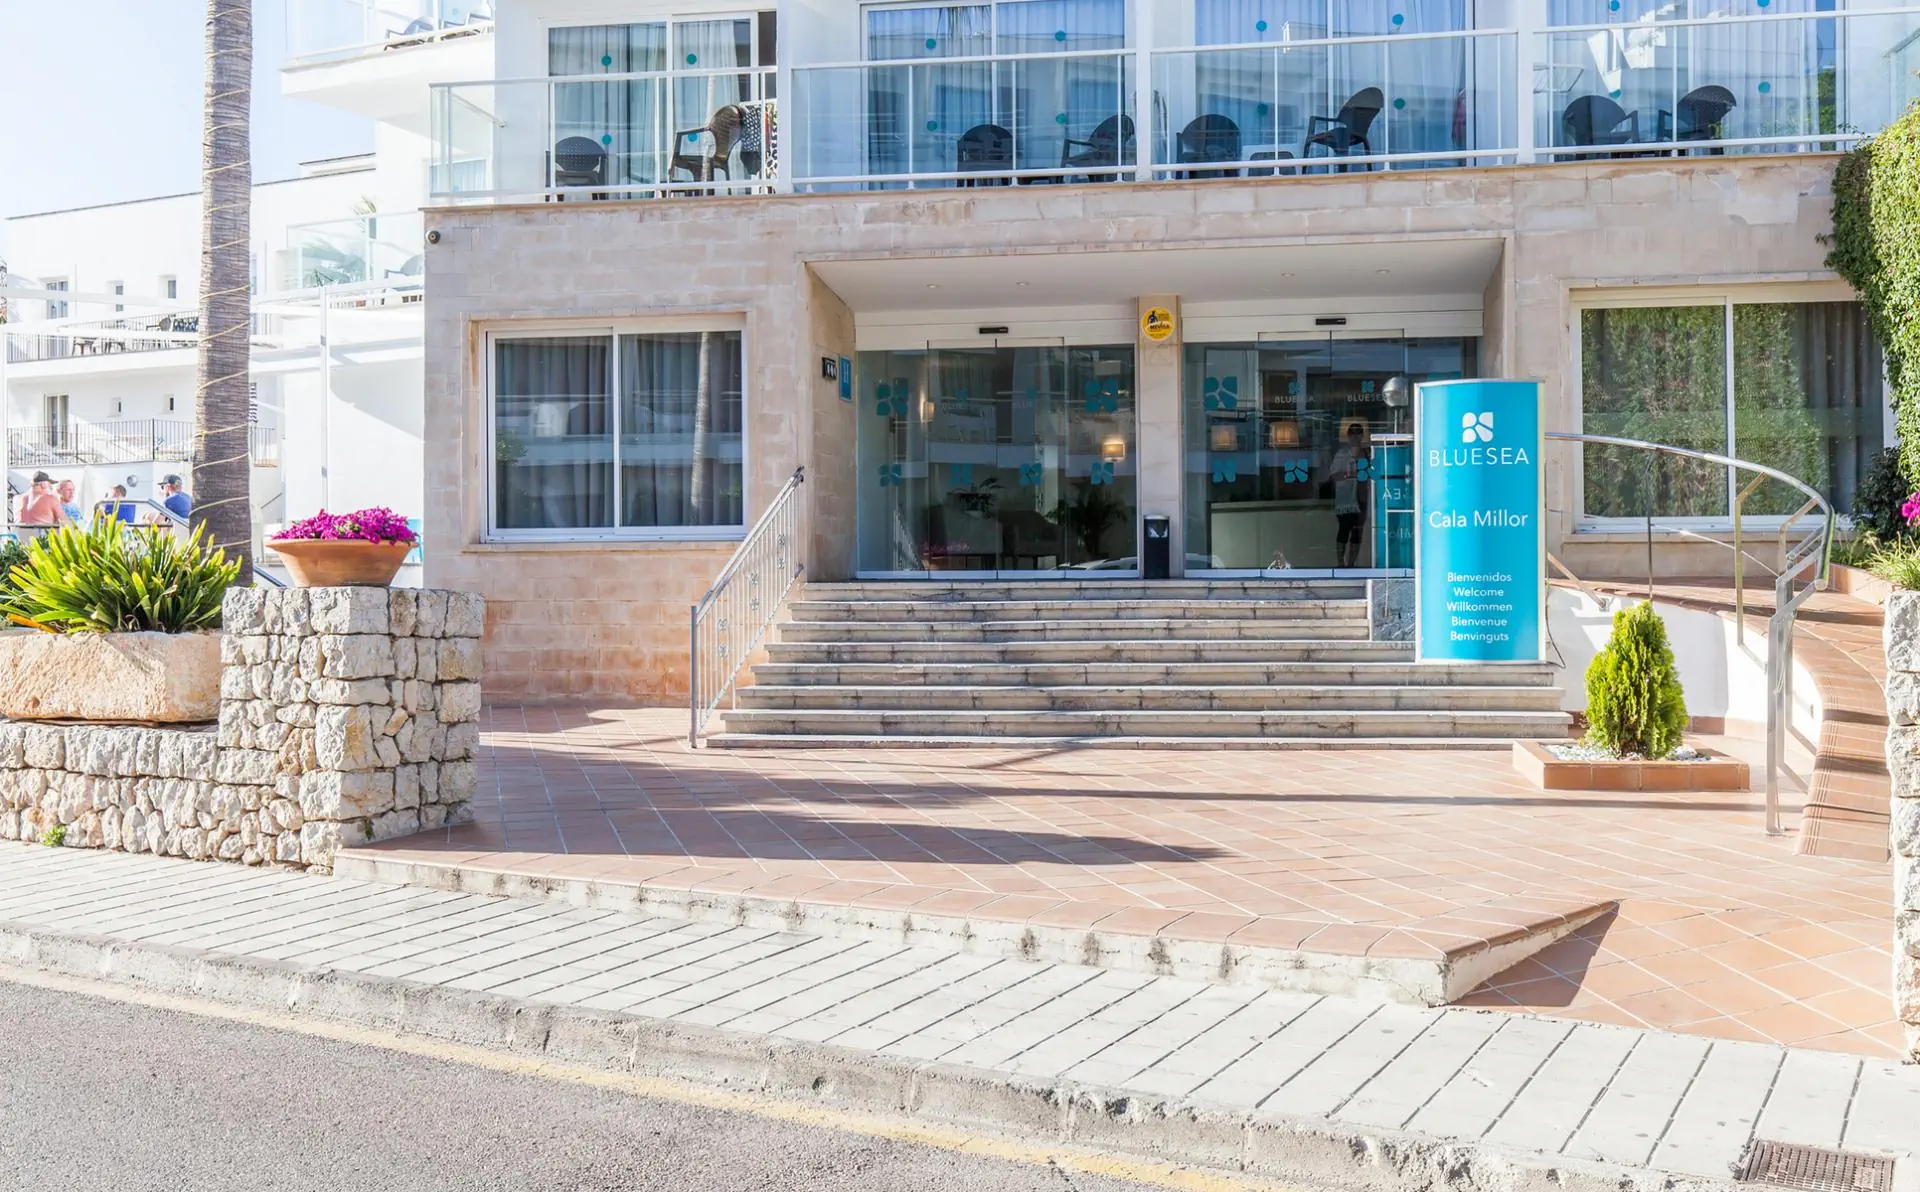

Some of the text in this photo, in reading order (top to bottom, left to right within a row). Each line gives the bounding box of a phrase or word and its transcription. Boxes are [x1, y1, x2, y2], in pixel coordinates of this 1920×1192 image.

[1347, 393, 1388, 402] BLUESE
[1429, 447, 1530, 467] BLUESEA
[1428, 508, 1529, 529] Cala Millor
[1447, 571, 1513, 583] Bienvenidos
[1453, 586, 1505, 597] Welcome
[1446, 601, 1513, 612] Willkommen
[1451, 616, 1508, 626] Bienvenue
[1450, 630, 1510, 644] Benvinguts
